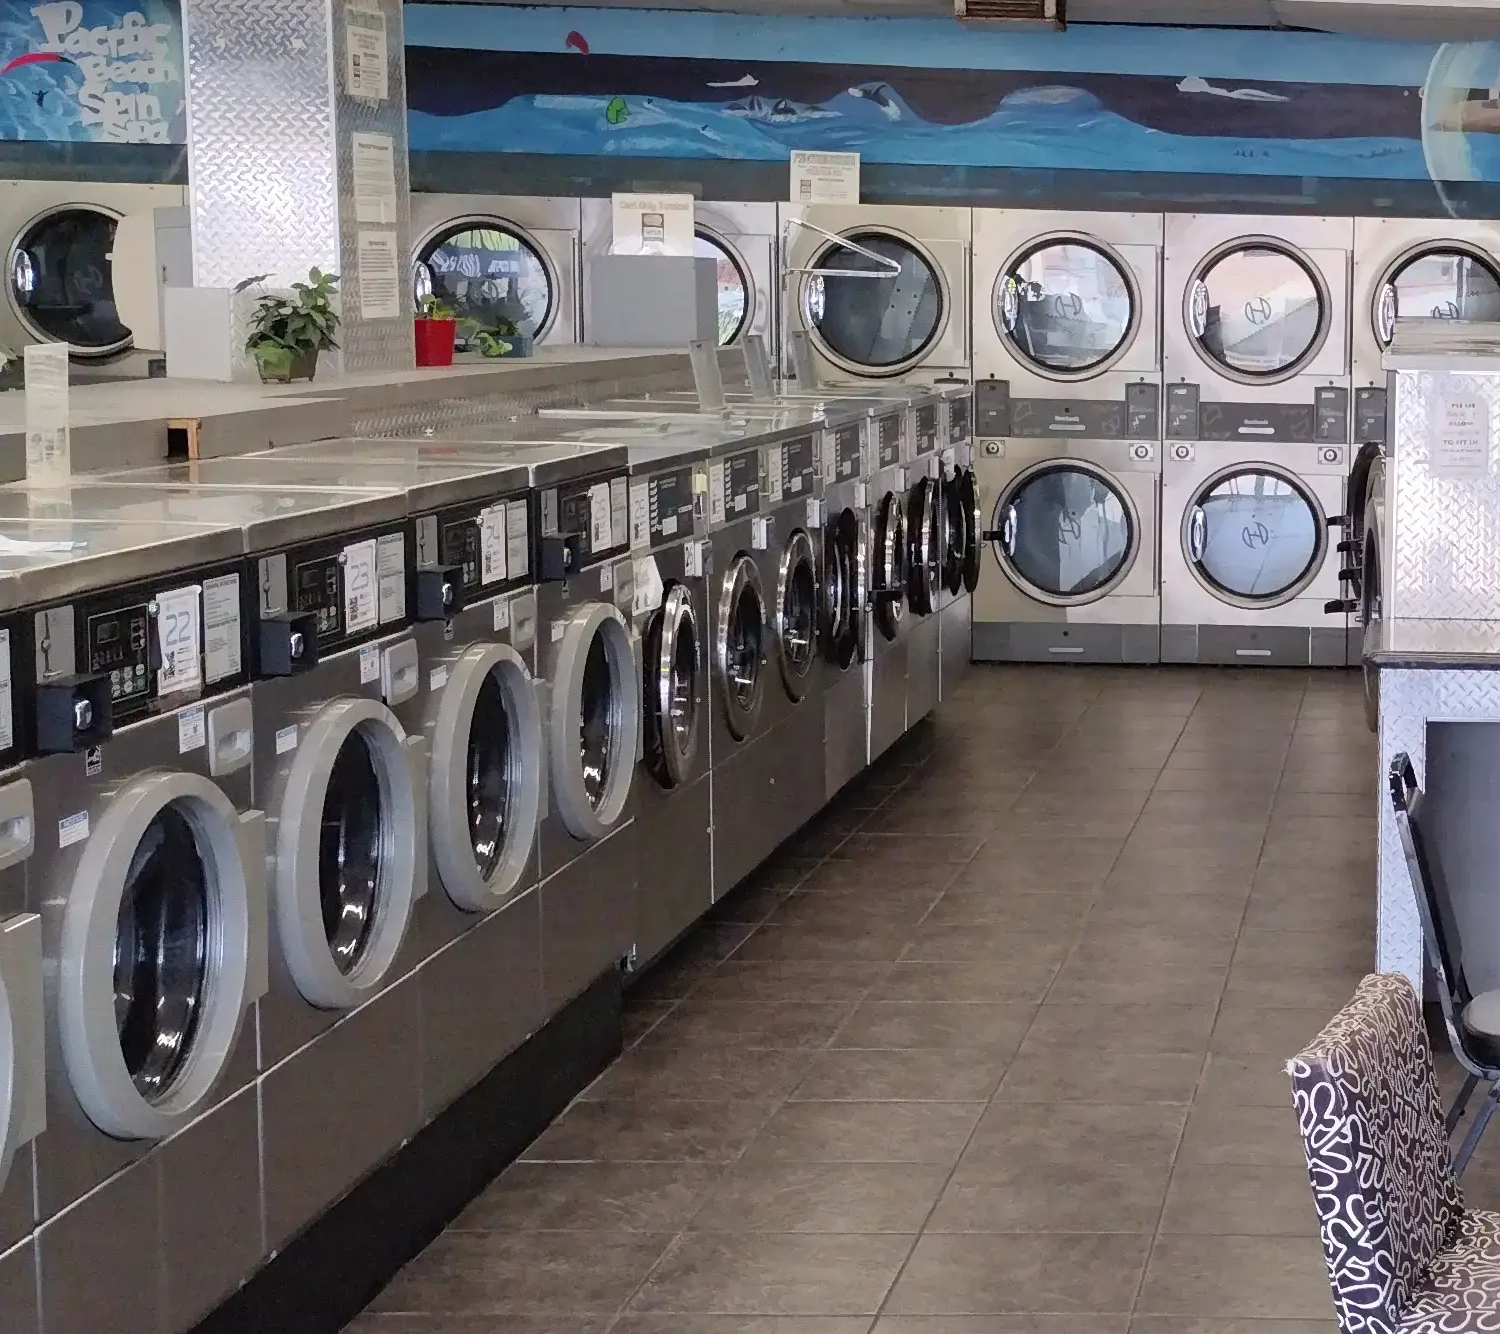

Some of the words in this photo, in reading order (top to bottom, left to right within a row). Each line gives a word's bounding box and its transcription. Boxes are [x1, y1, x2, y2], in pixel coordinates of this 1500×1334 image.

[30, 0, 171, 58] Pacific
[350, 561, 370, 591] 23
[165, 610, 191, 646] 22
